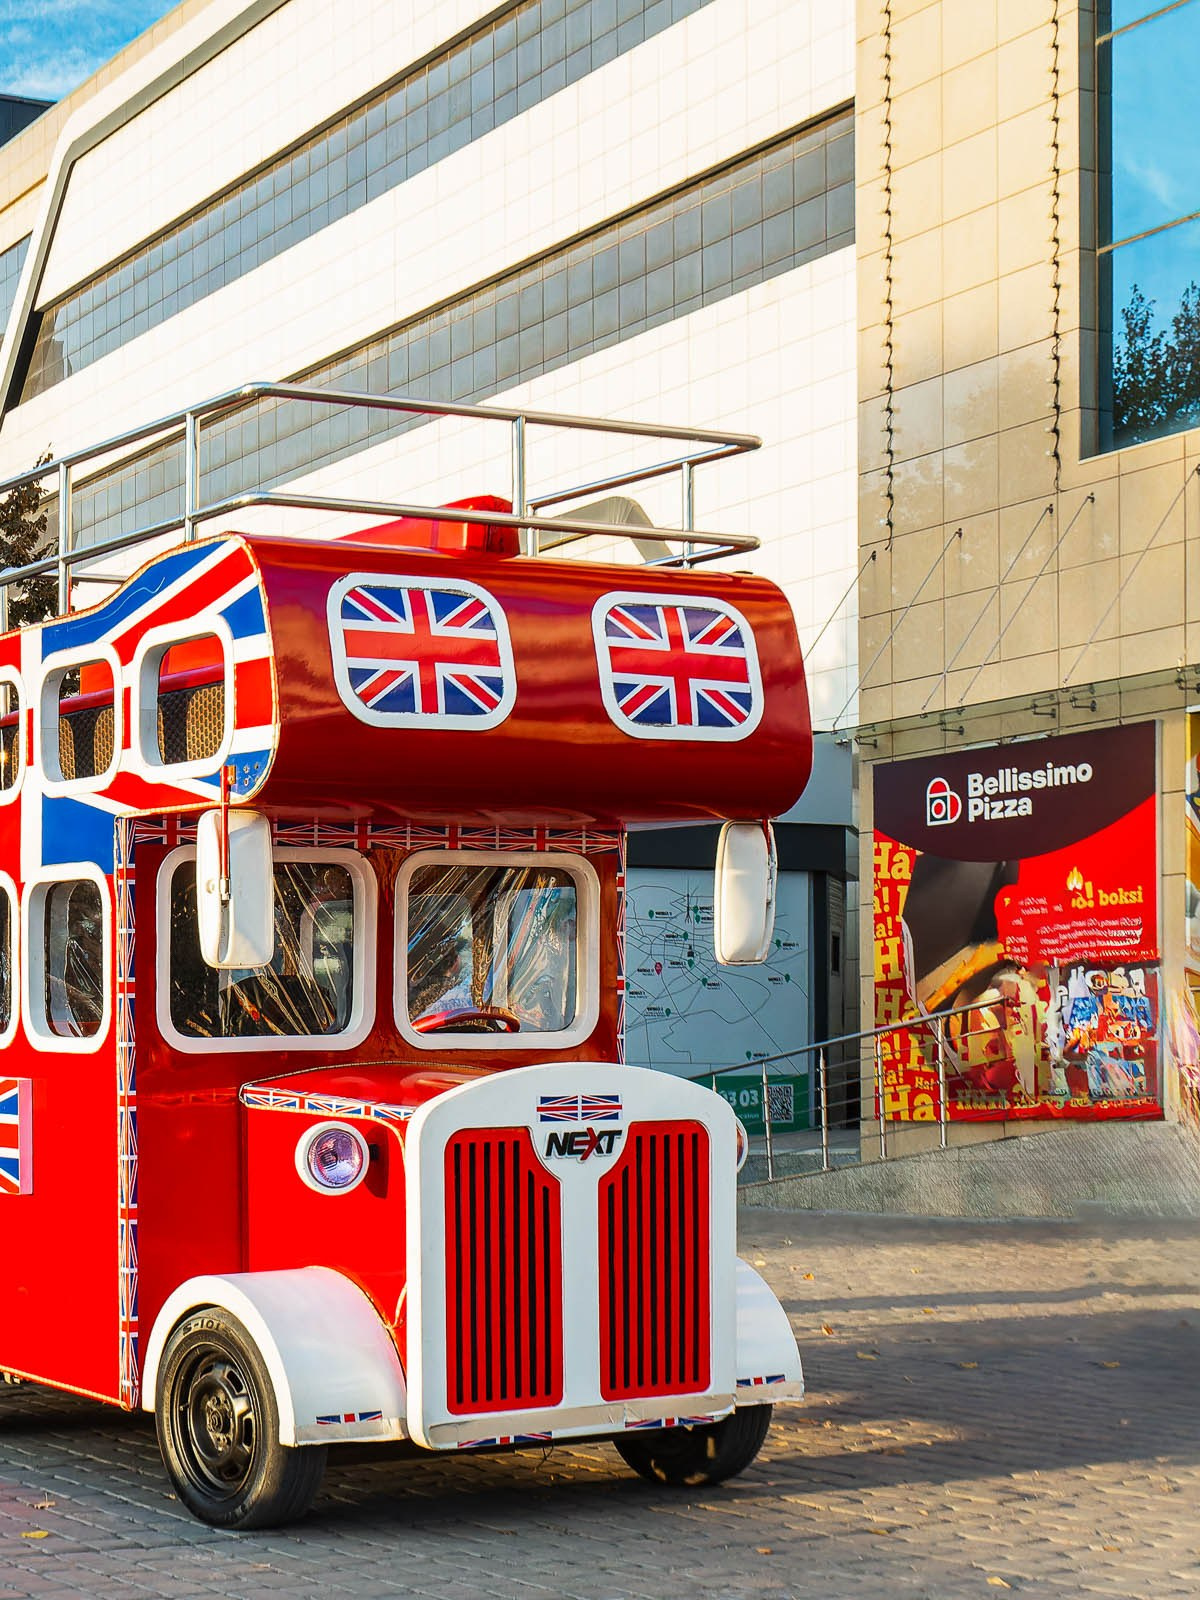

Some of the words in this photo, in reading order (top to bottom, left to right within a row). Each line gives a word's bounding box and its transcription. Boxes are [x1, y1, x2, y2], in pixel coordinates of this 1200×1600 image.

[967, 762, 1093, 797] Bellissimo
[967, 797, 1032, 822] Pizza
[1098, 885, 1143, 906] boksi
[740, 1089, 759, 1107] 03
[546, 1127, 622, 1160] NEXT
